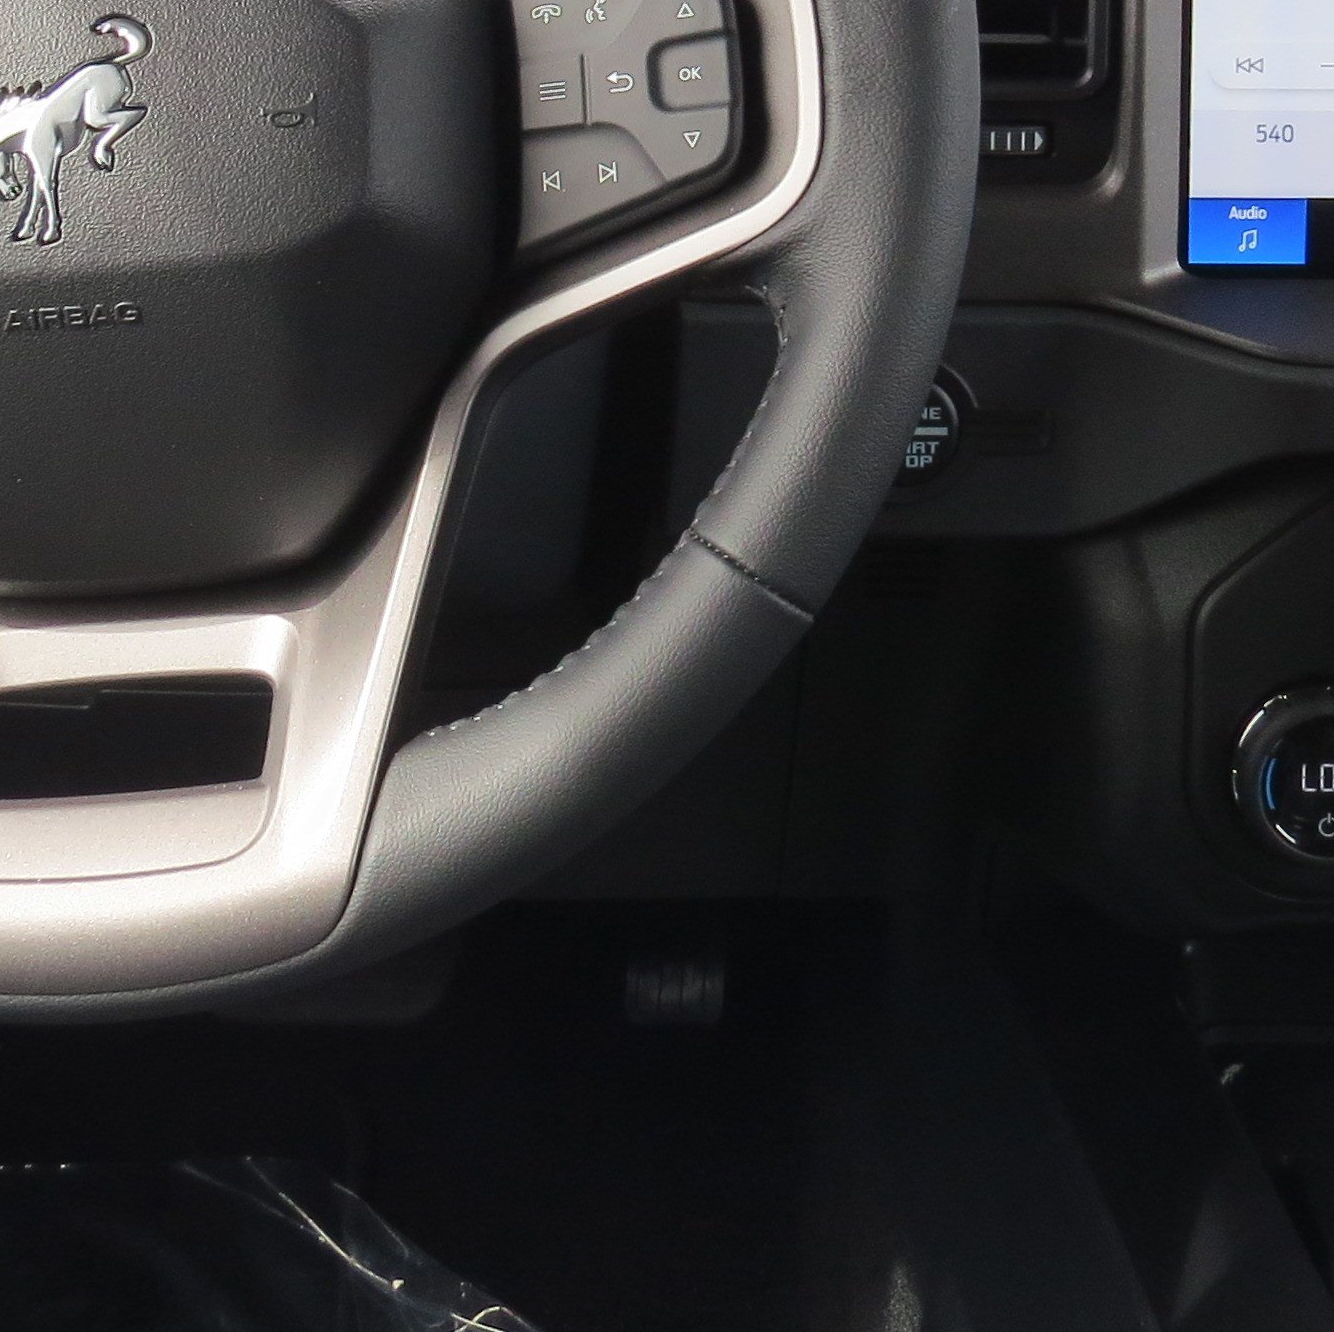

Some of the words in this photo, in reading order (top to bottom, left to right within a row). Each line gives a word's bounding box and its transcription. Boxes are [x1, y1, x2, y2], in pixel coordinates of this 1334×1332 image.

[679, 67, 702, 81] OK
[1256, 124, 1294, 144] 540
[1228, 206, 1267, 221] Audio
[4, 300, 143, 332] AIRBAG
[905, 456, 933, 468] OP
